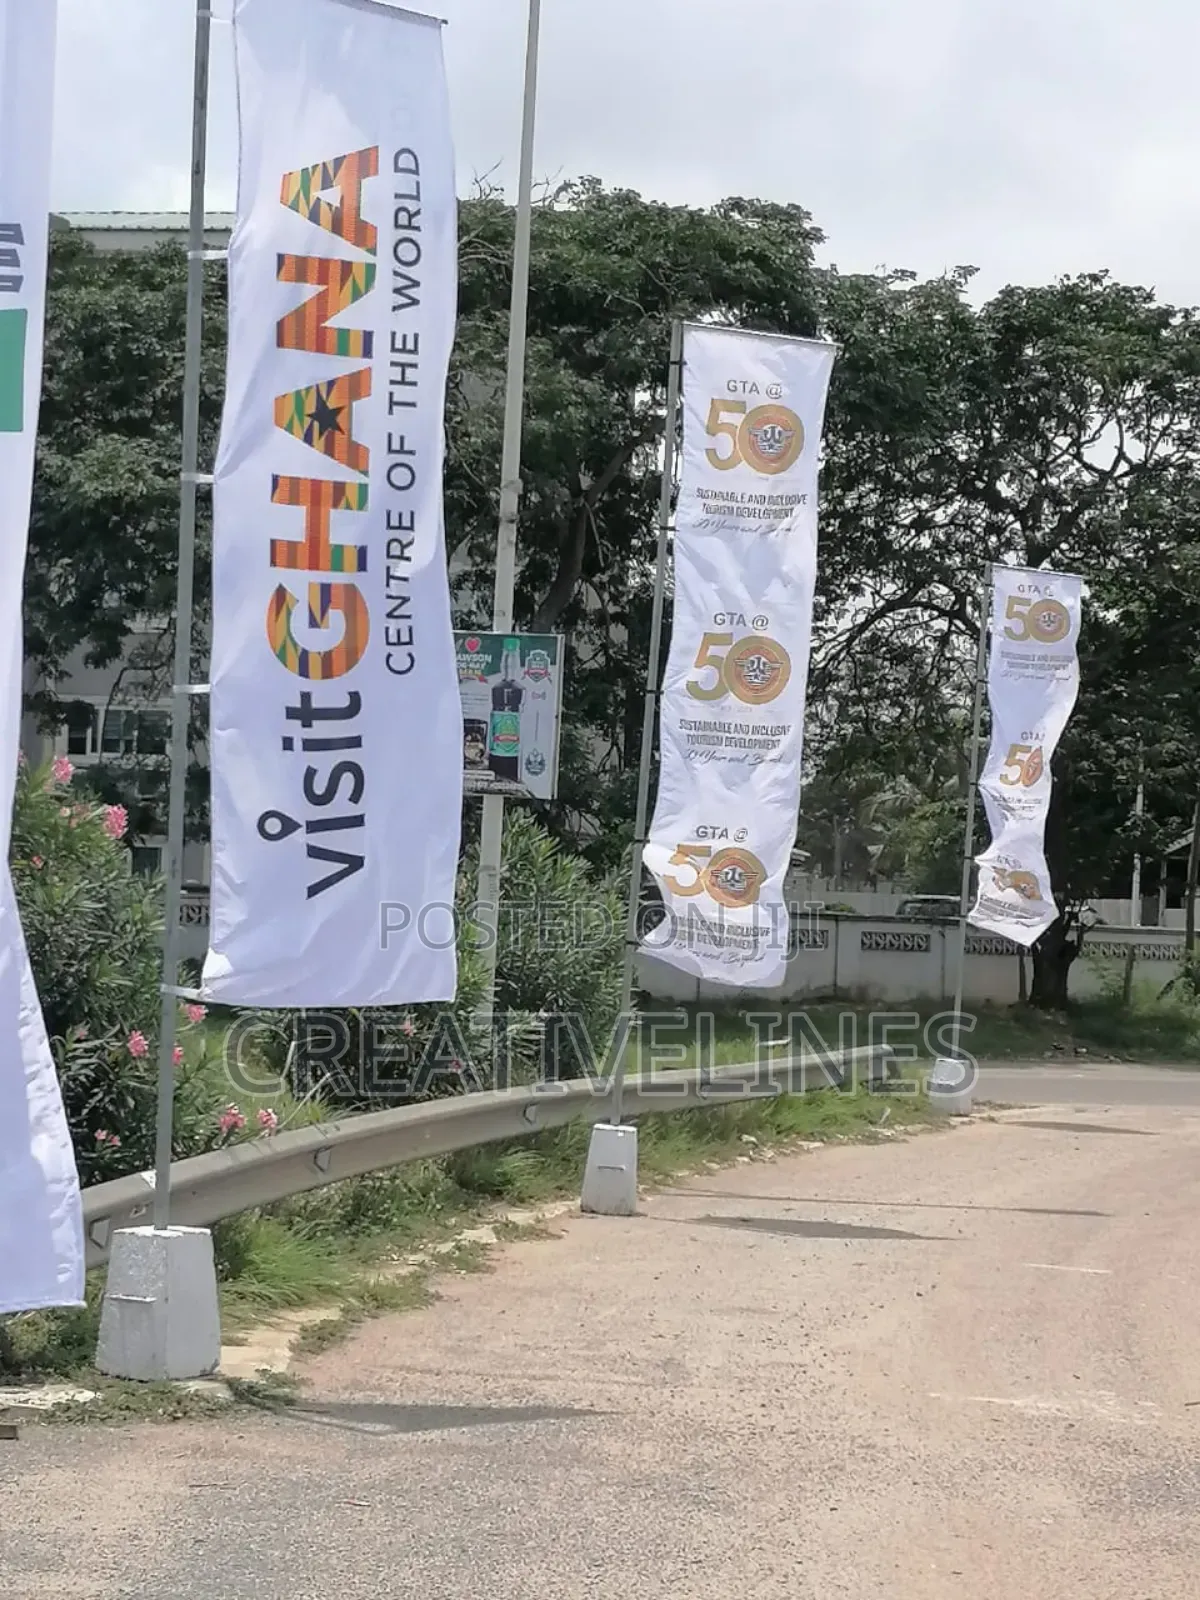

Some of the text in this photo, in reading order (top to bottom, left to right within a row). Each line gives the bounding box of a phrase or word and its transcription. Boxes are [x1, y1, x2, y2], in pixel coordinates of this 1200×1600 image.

[727, 379, 760, 395] GTA
[385, 147, 422, 676] CENTRE OF THE WORLD
[705, 398, 805, 475] 50
[748, 493, 766, 506] AND
[1017, 584, 1041, 595] GTA
[713, 611, 769, 631] GTA @
[1004, 595, 1071, 644] 50
[685, 631, 792, 706] 50
[733, 723, 750, 736] AND
[695, 825, 729, 839] GTA
[662, 843, 768, 909] 50
